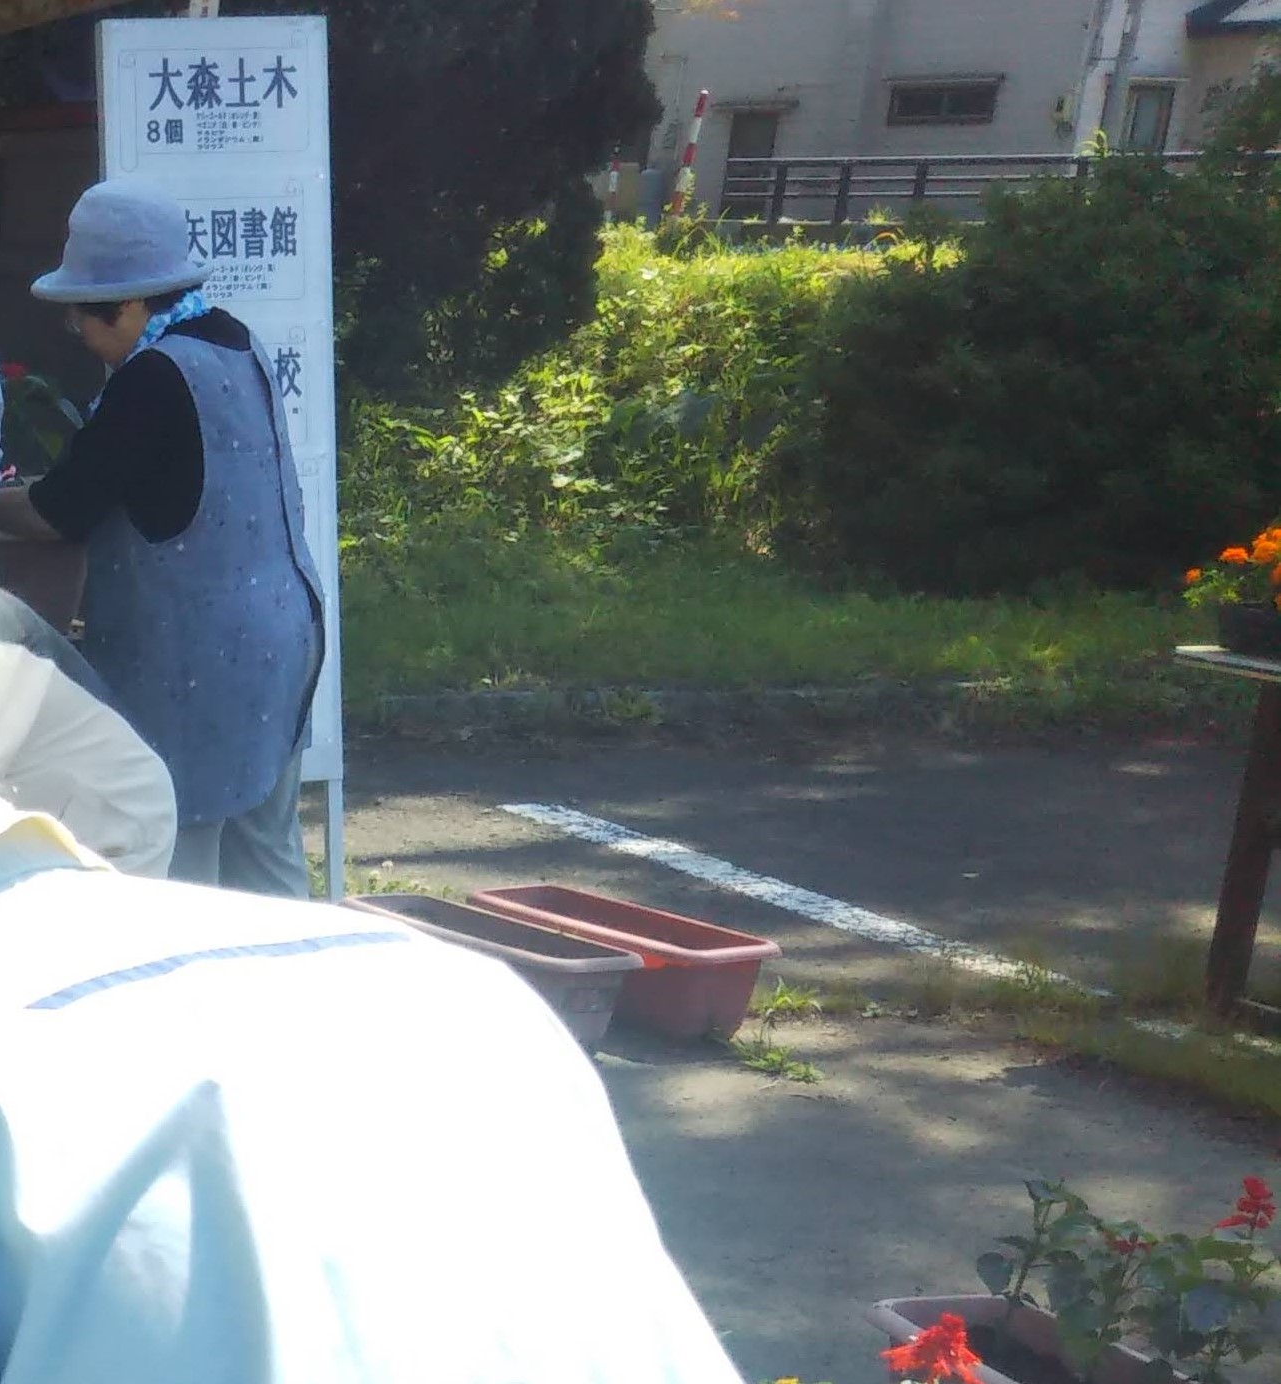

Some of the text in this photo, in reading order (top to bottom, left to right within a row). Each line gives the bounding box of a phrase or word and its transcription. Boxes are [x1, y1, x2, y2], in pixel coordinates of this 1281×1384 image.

[148, 55, 299, 110] 大森土木
[146, 118, 184, 145] 8個
[186, 206, 298, 259] 矢図書館
[274, 347, 303, 398] 校
